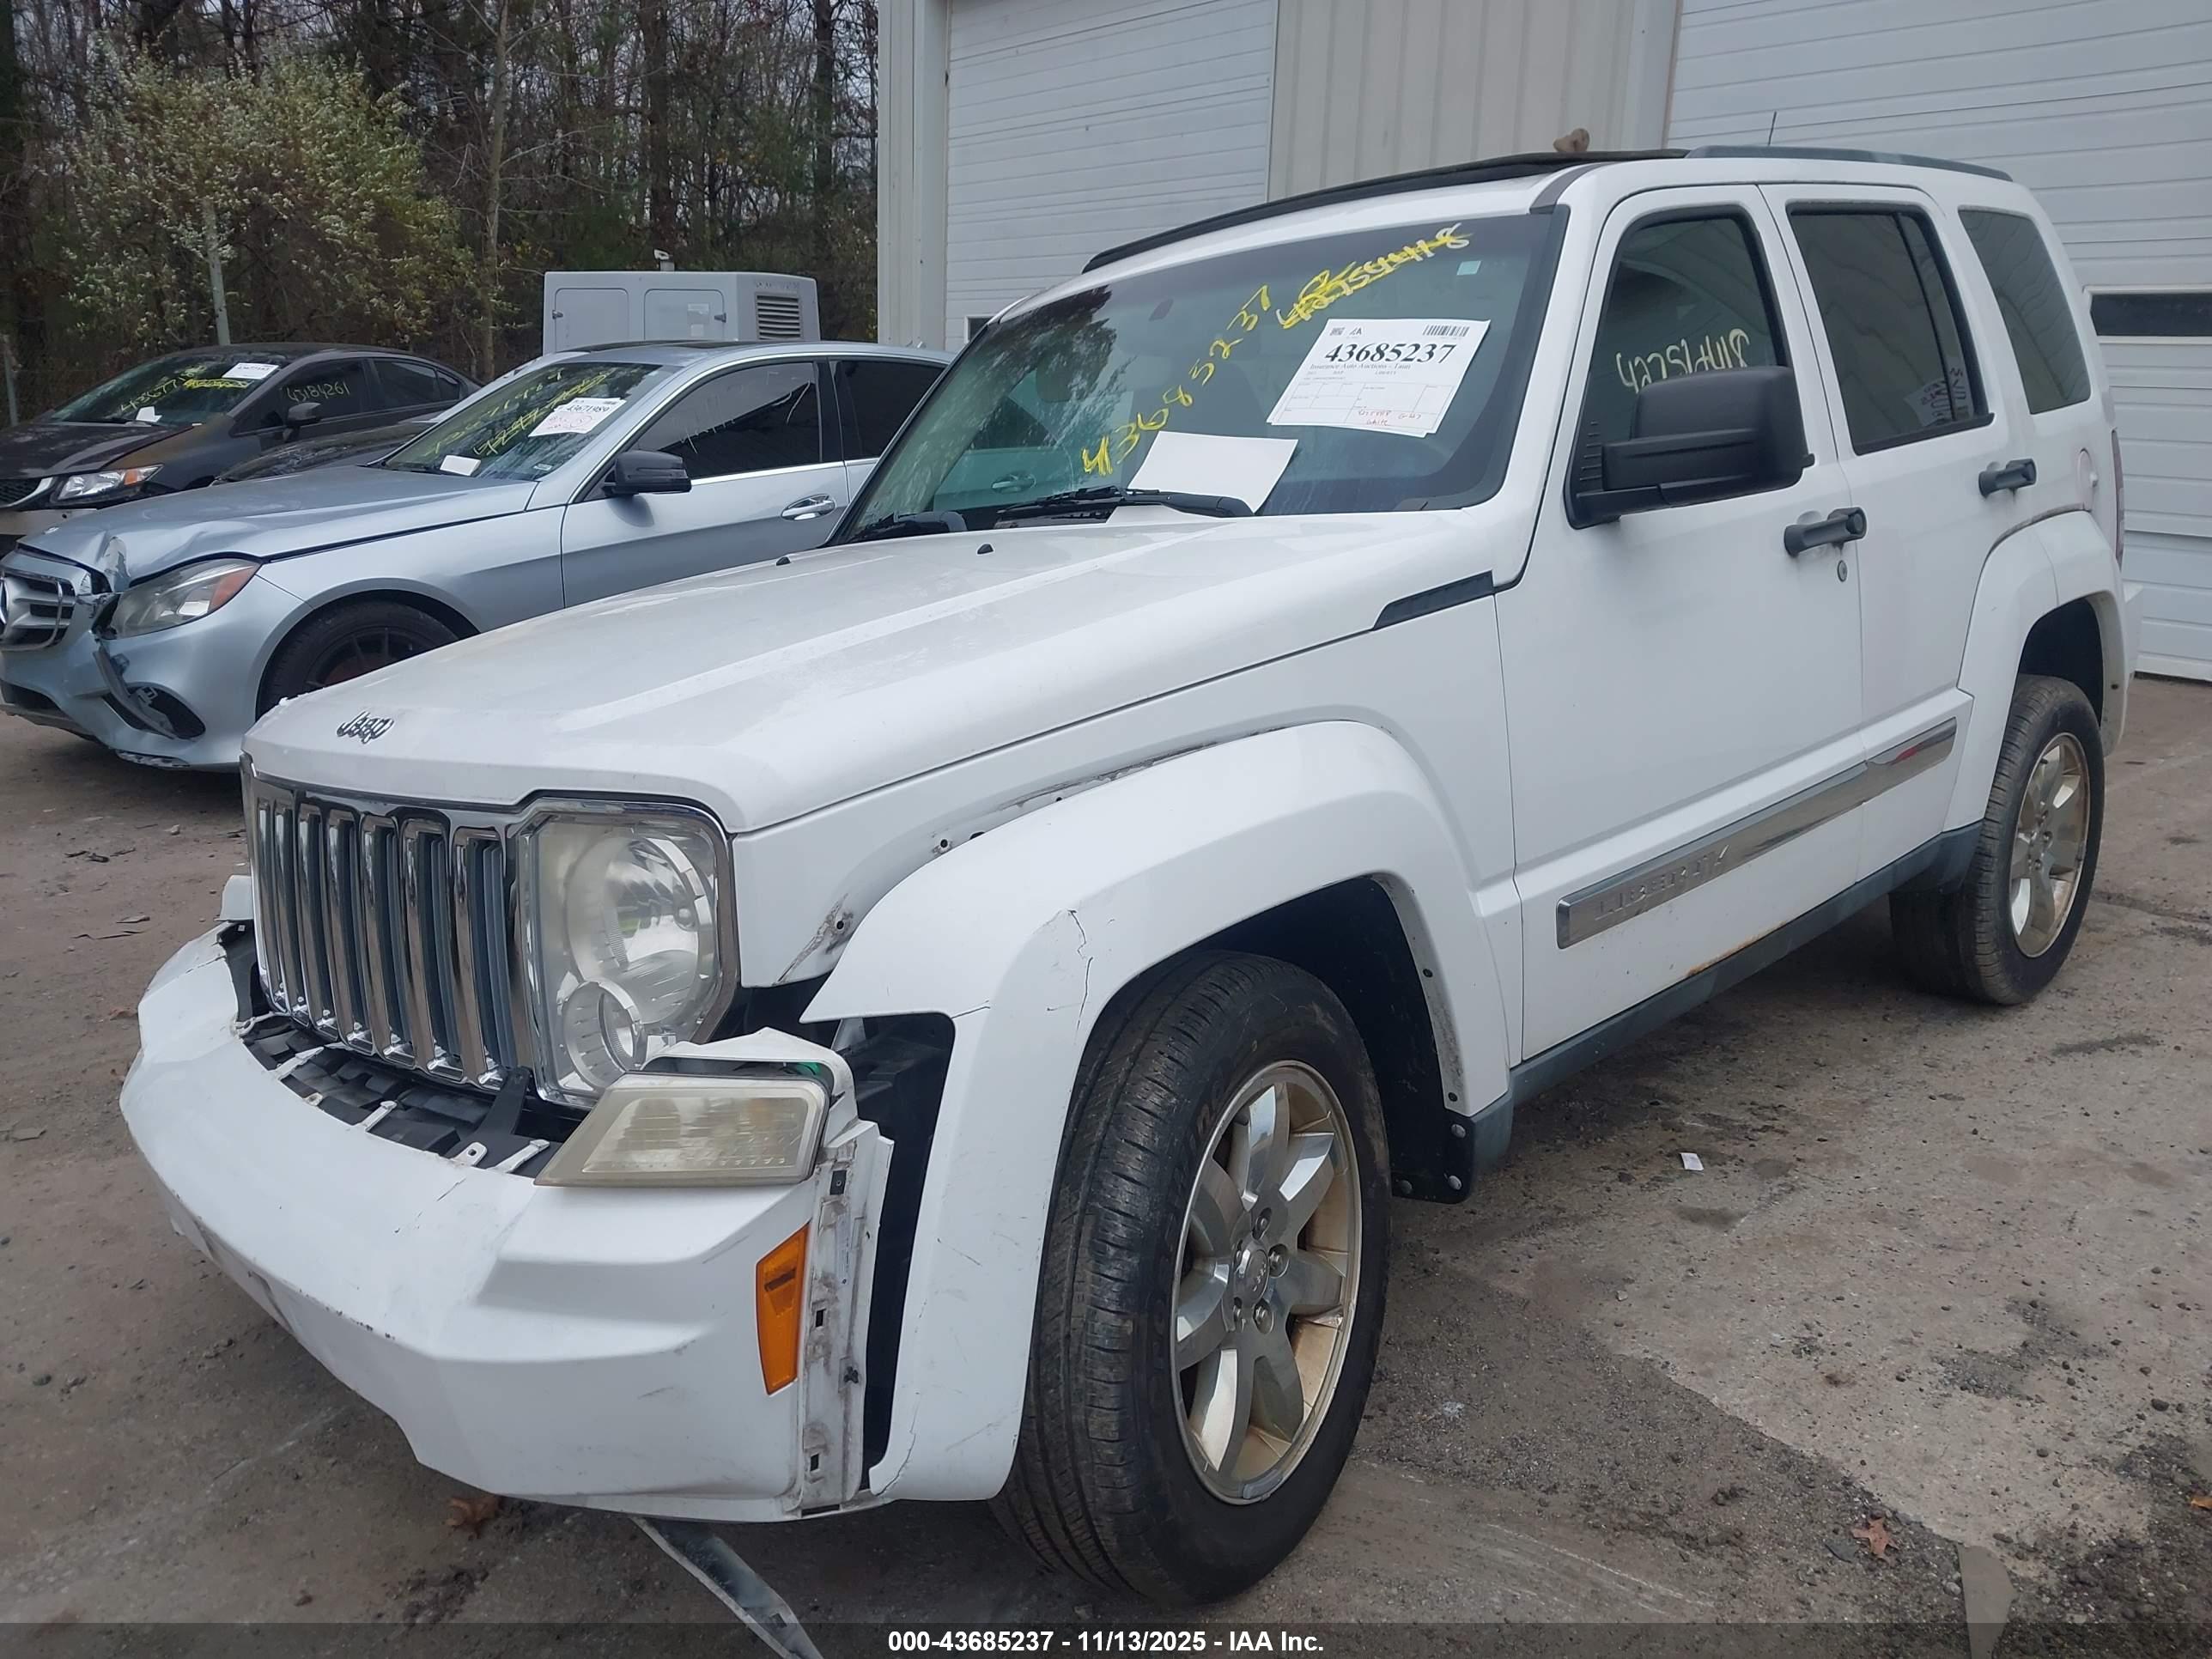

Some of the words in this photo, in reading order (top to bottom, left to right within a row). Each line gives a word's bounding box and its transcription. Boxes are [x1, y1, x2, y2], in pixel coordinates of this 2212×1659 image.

[1325, 343, 1457, 363] 43685237
[1081, 284, 1271, 476] 43685237
[336, 710, 395, 744] Jeep
